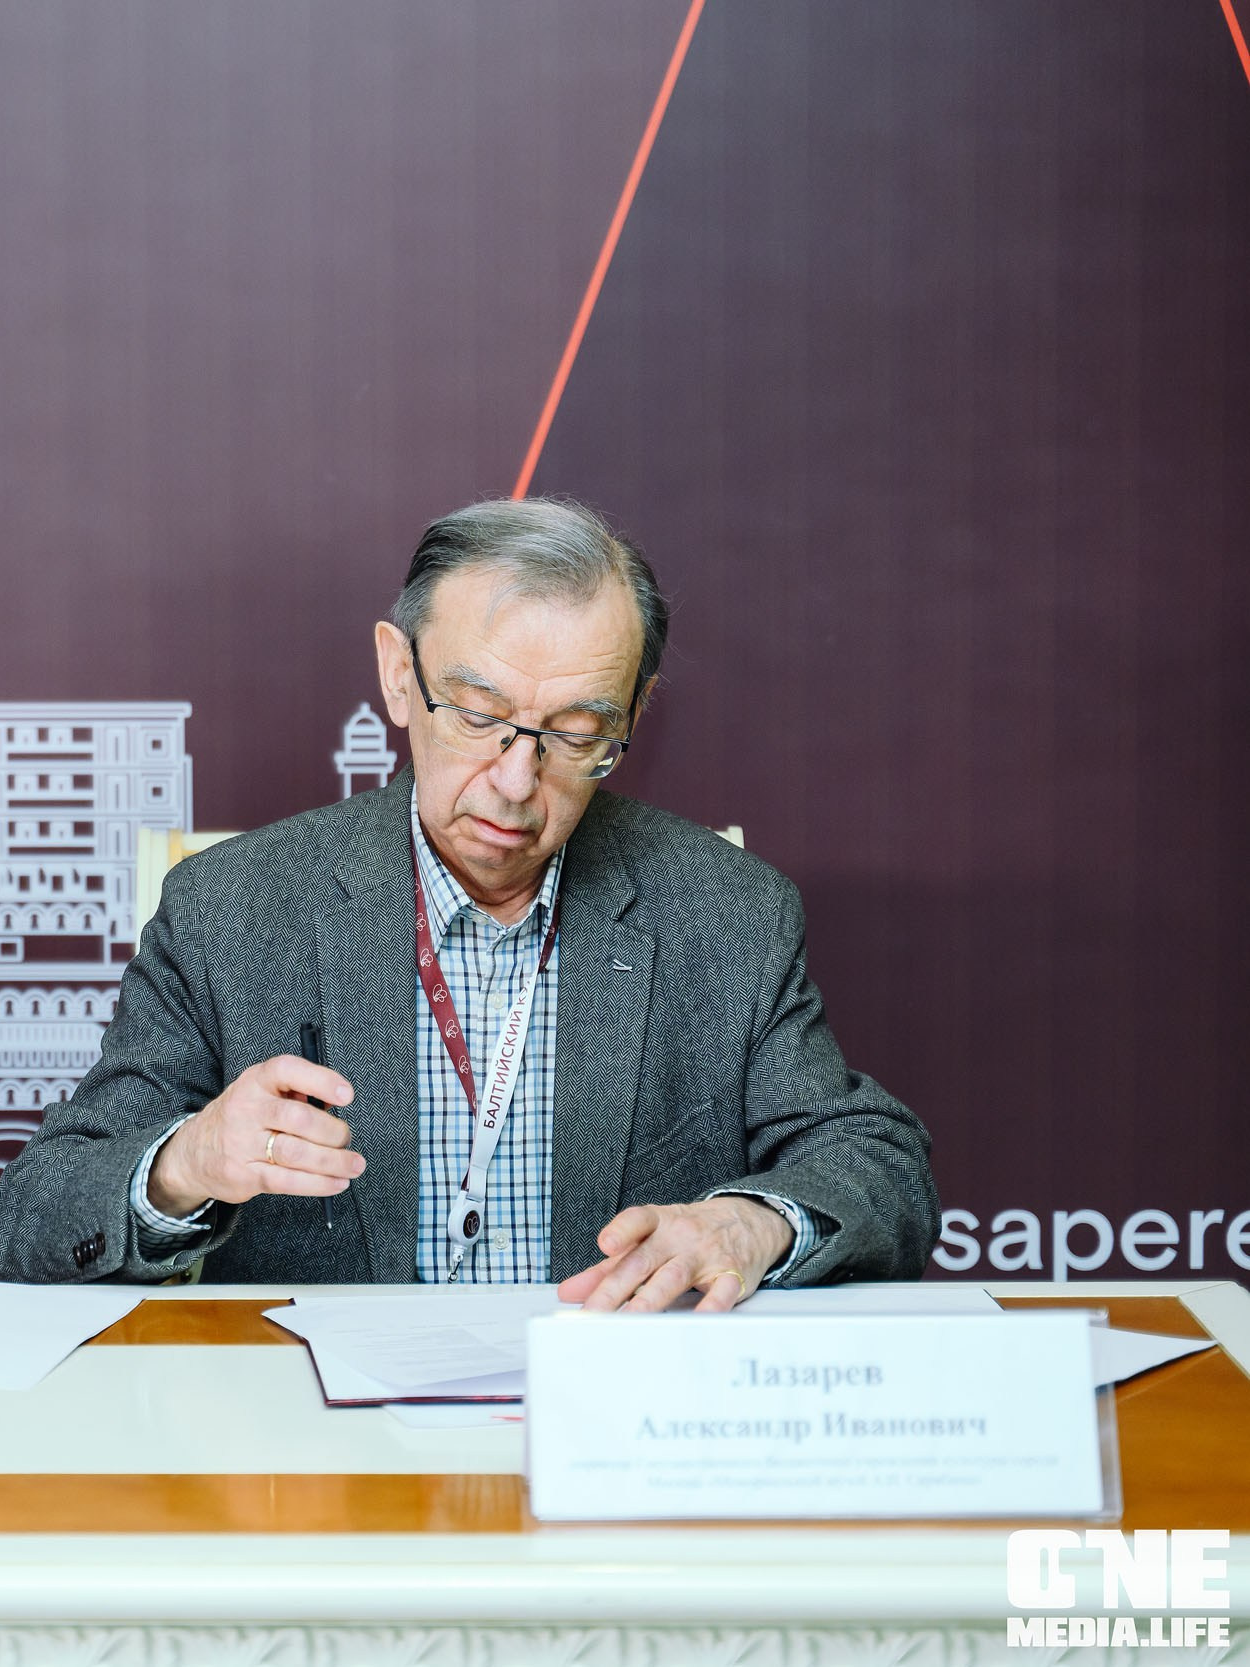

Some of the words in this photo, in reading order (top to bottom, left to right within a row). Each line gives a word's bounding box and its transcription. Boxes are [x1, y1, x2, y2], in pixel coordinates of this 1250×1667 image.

[483, 1010, 523, 1129] БАЛТИЙСКИЙ
[731, 1357, 885, 1392] Лазарев
[635, 1412, 813, 1444] Александр
[823, 1412, 988, 1440] Иванович
